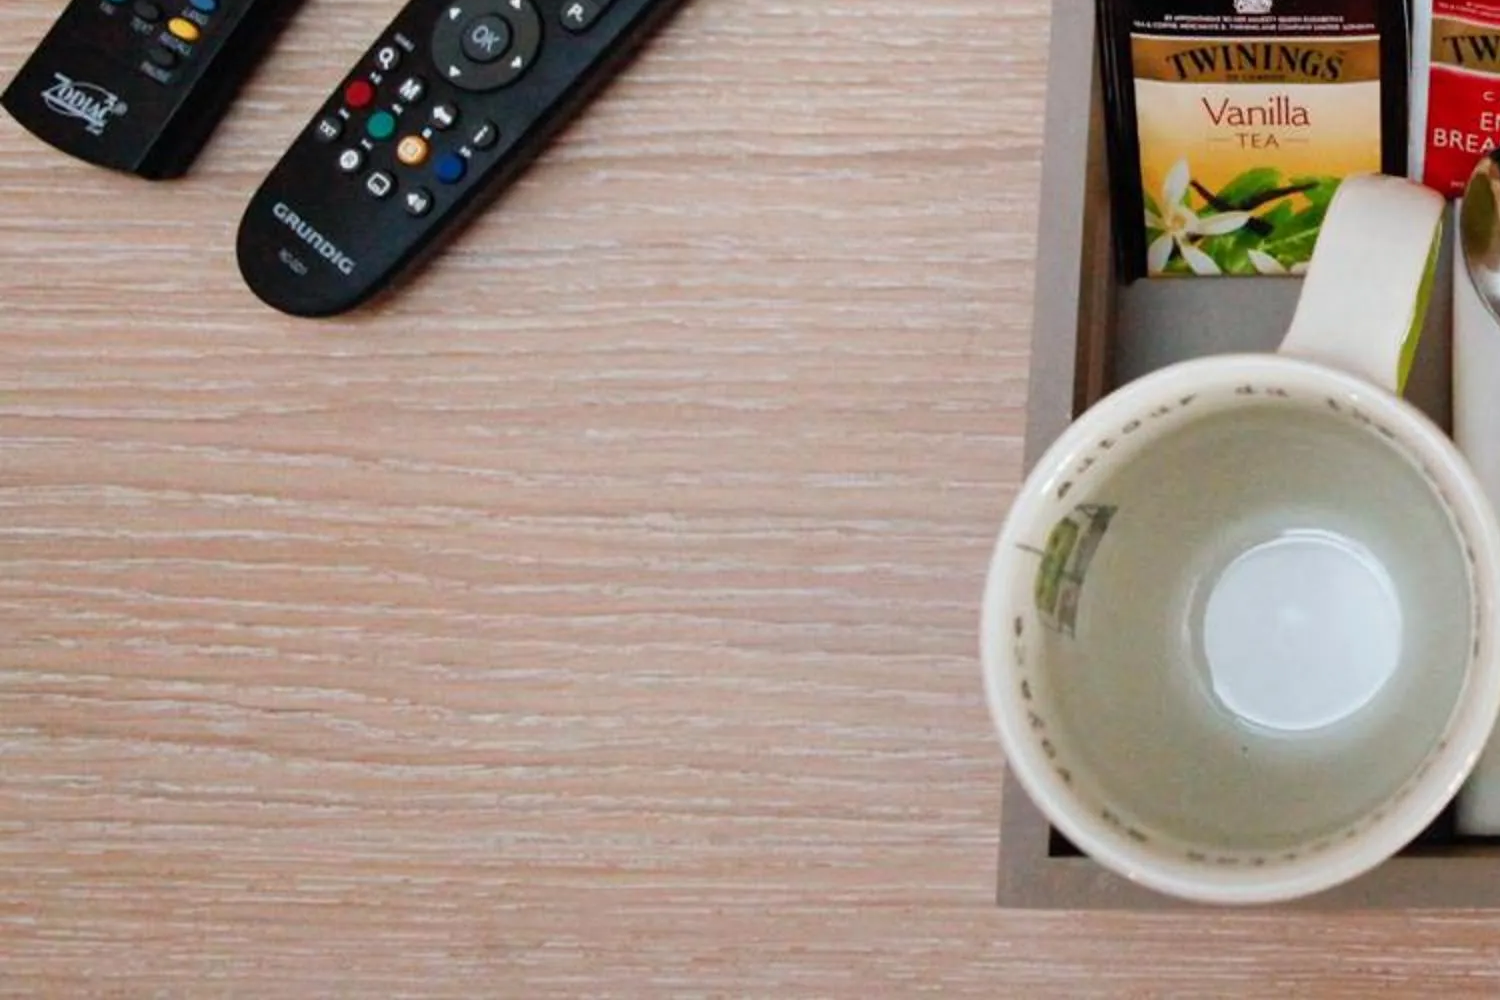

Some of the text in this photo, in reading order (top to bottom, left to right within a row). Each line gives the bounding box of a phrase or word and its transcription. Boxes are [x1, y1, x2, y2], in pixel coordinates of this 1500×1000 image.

[471, 25, 500, 53] OK
[1165, 43, 1343, 81] TWININGS
[400, 78, 421, 100] M
[1201, 96, 1311, 127] Vanilla
[1235, 133, 1279, 149] TEA
[272, 202, 356, 275] GRUNDIG
